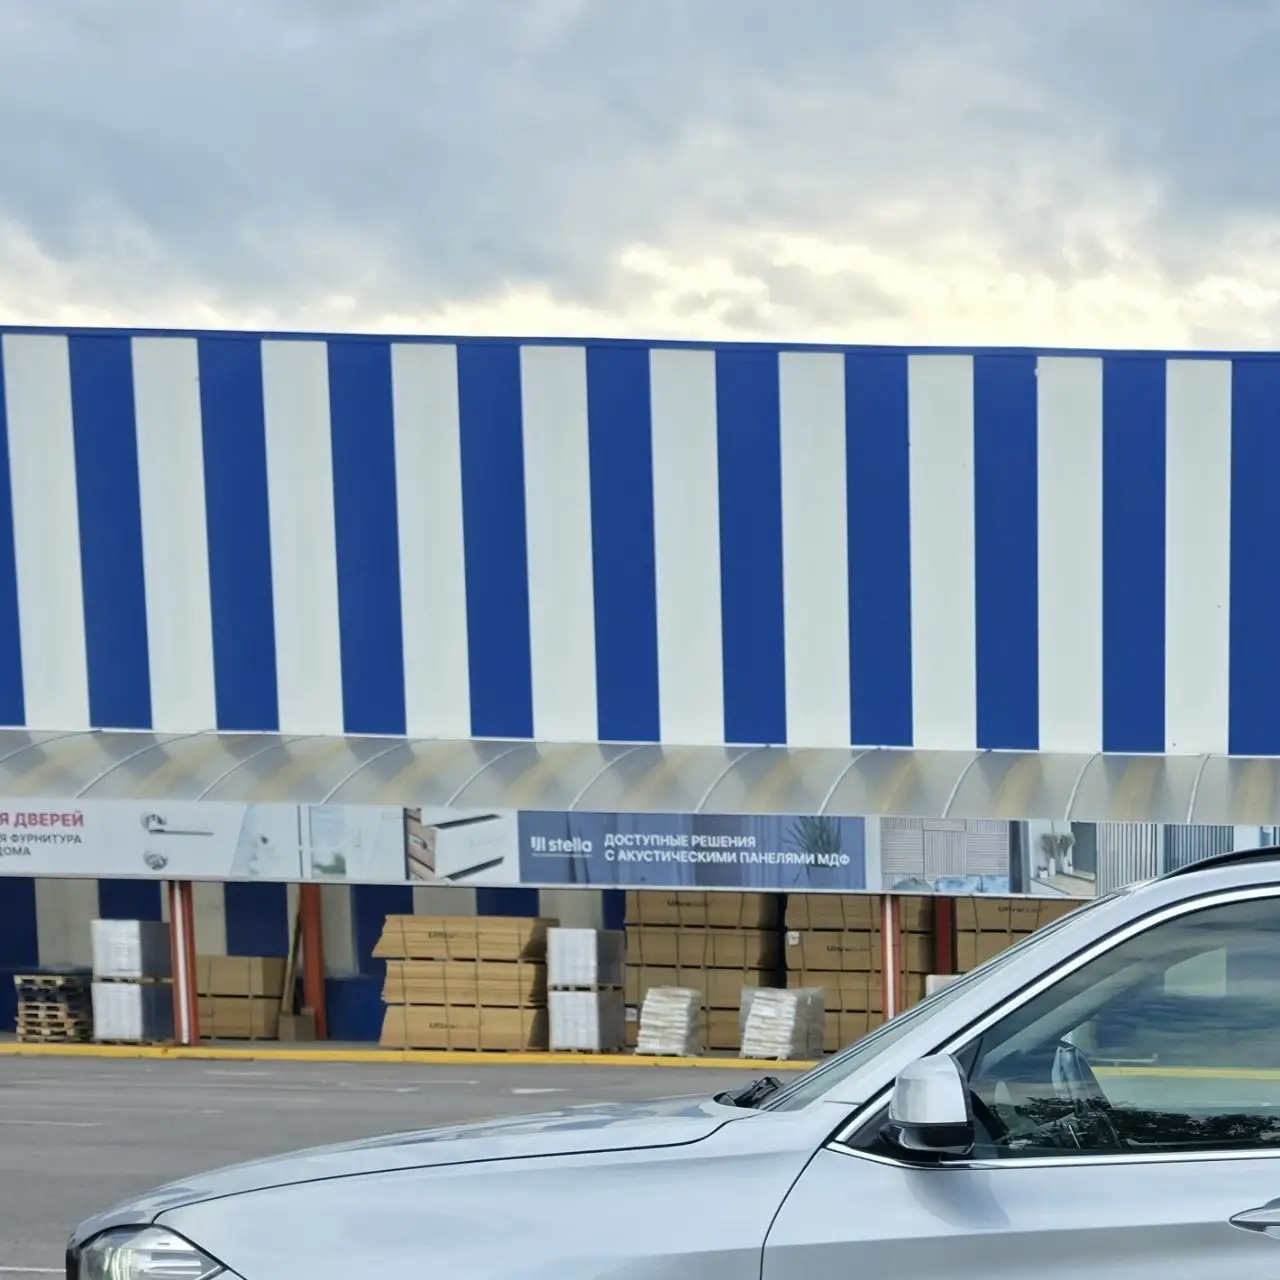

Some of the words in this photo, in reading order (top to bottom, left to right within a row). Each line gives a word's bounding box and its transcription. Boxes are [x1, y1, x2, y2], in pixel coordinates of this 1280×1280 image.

[14, 810, 84, 828] ДВЕРЕЙ
[10, 833, 82, 844] ФУРНИТУРА
[548, 836, 593, 853] stella
[604, 833, 689, 847] ДОСТУПНЫЕ
[691, 835, 757, 848] РЕШЕНИЯ
[604, 849, 615, 862] С
[617, 849, 737, 863] АКУСТИЧЕСКИМИ
[739, 852, 814, 865] ПАНЕЛЯМИ
[817, 853, 851, 867] МДФ
